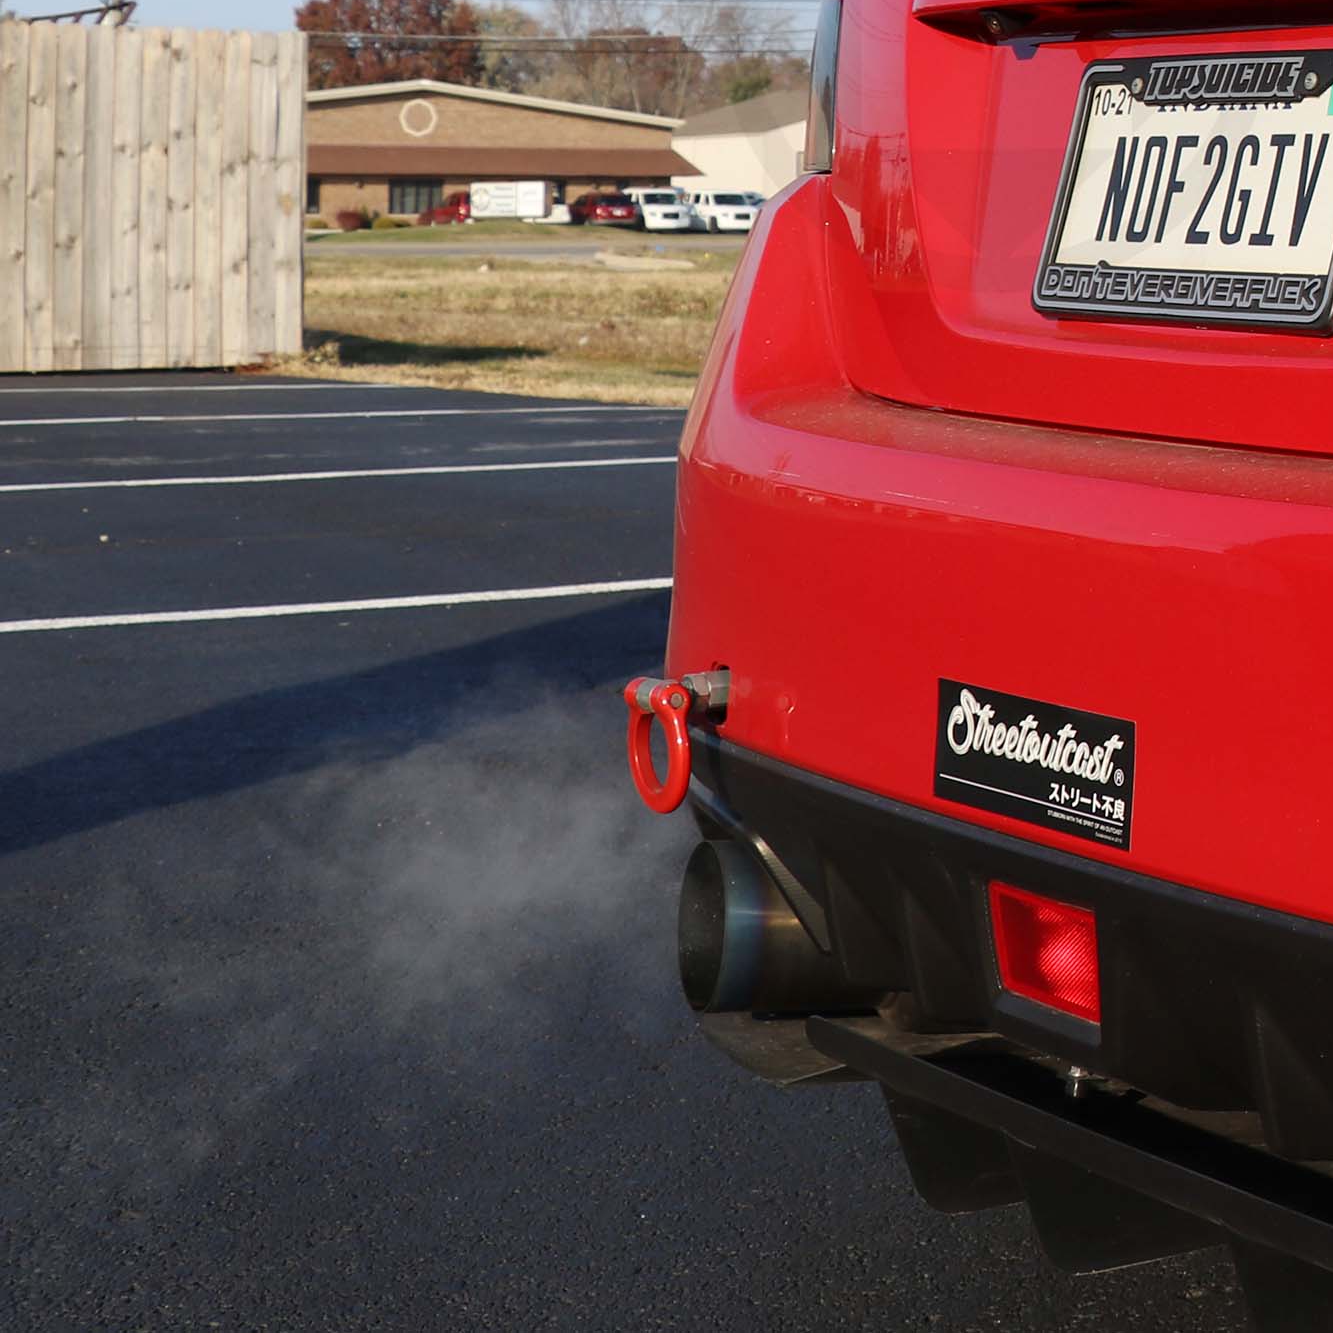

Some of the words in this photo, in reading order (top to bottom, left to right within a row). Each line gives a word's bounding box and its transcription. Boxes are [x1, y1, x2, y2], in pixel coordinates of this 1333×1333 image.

[1095, 133, 1329, 247] NOF2GIV
[947, 688, 1125, 784] Streetoutcast
[1048, 782, 1125, 821] ストリート不良
